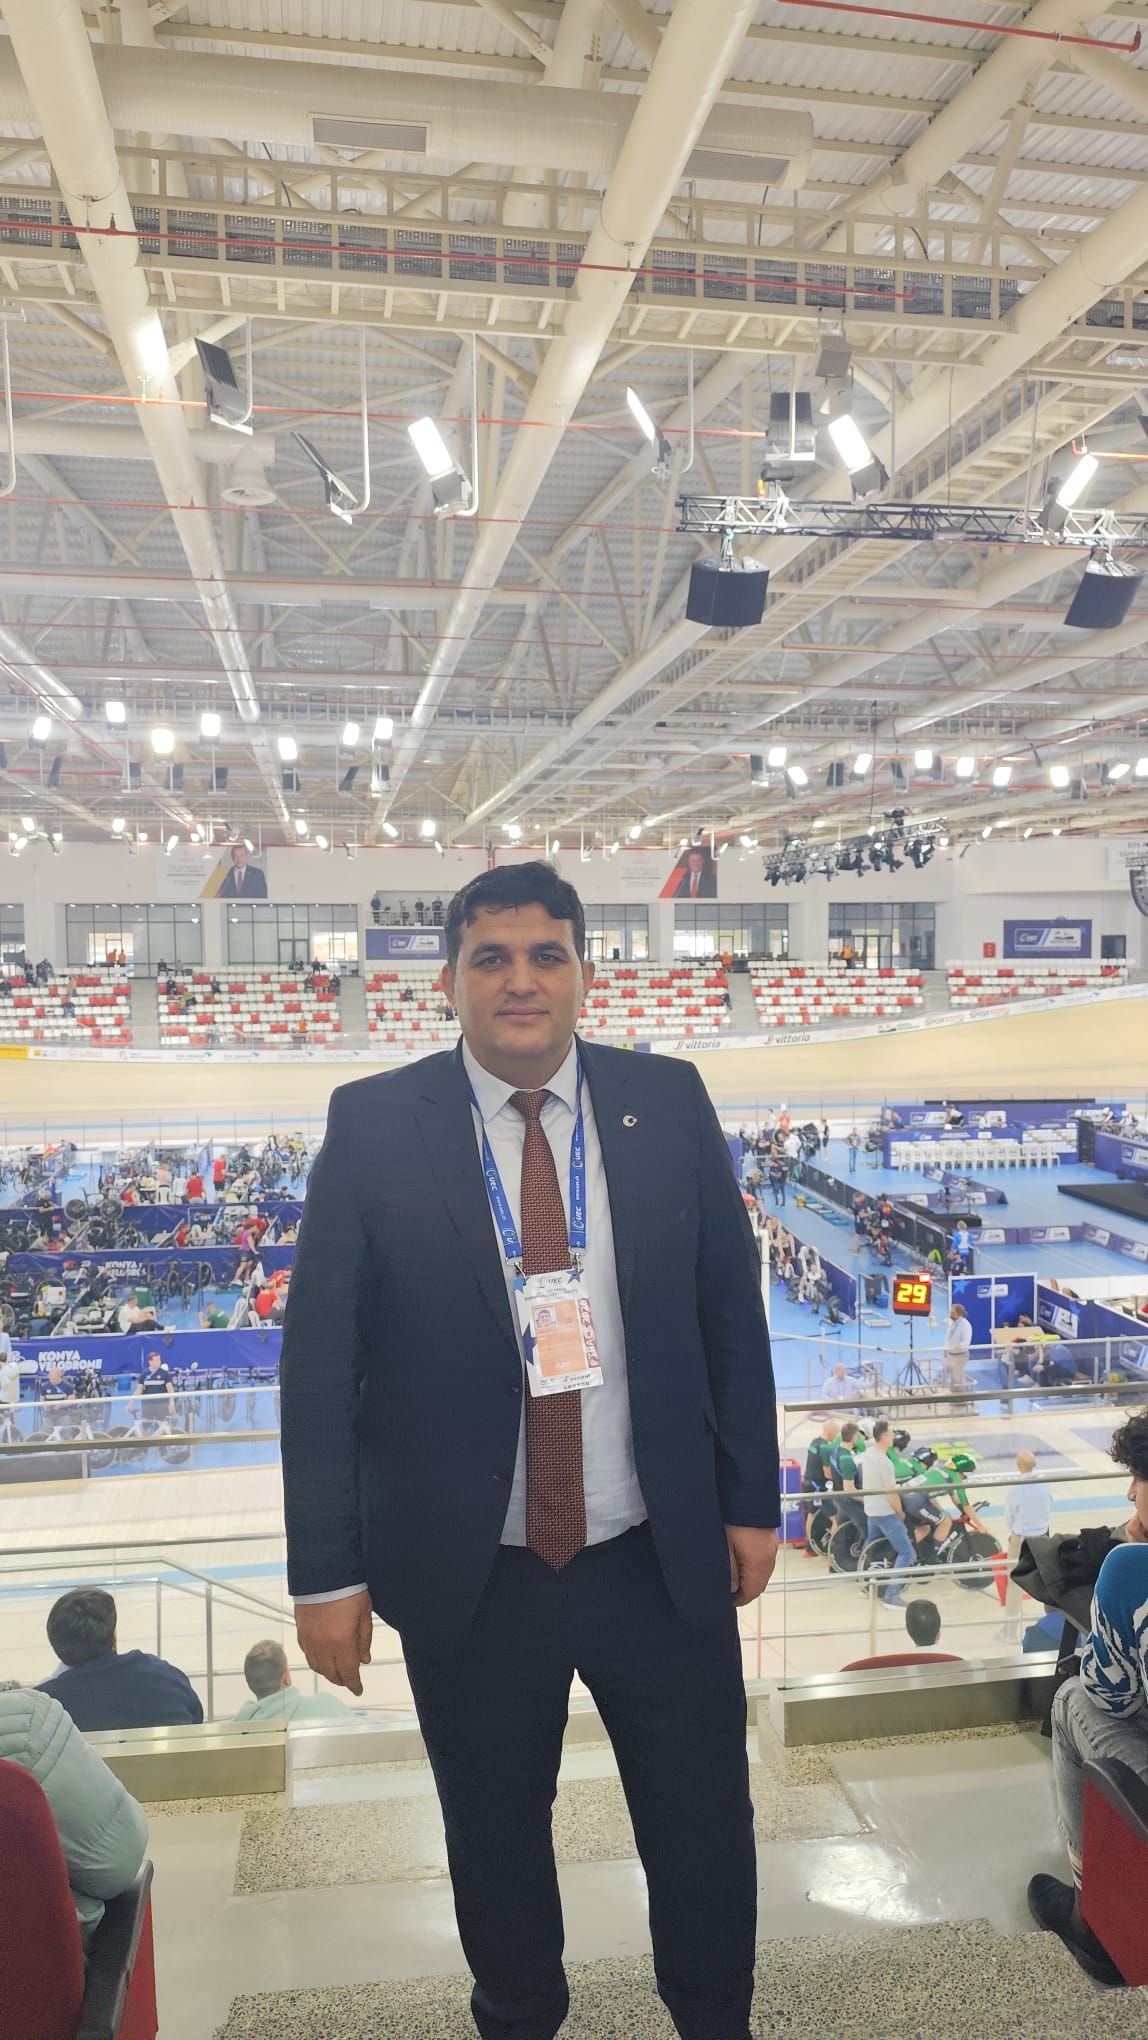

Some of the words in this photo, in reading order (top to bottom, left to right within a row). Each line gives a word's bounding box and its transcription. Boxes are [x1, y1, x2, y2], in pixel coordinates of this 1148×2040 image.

[684, 1039, 721, 1049] vittoria
[775, 1033, 811, 1045] vittoria
[897, 1283, 927, 1304] 29
[38, 1350, 81, 1361] KONYA
[39, 1359, 103, 1372] VELODROME
